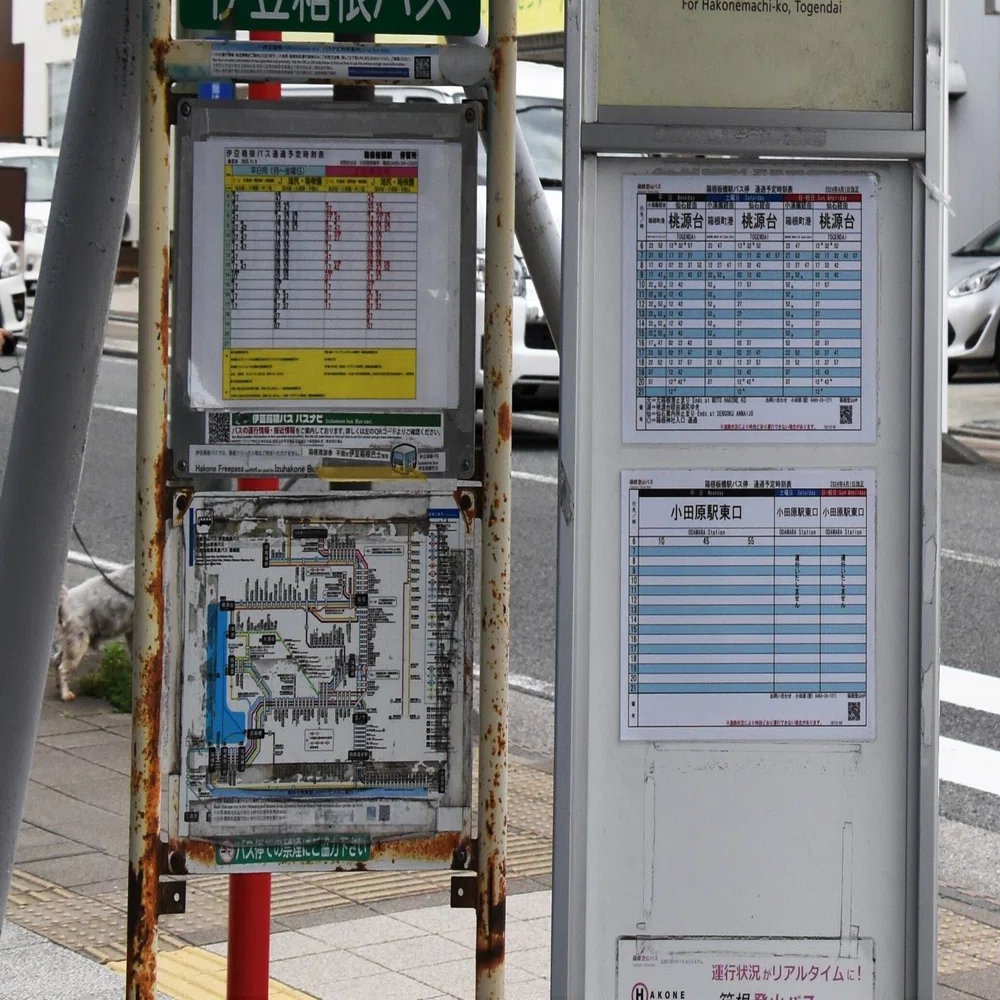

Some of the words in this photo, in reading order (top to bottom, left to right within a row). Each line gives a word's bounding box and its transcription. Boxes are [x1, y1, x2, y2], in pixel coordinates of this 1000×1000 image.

[795, 0, 842, 16] Togendai
[668, 212, 704, 230] 桃源台
[708, 216, 733, 226] 箱根町港
[742, 212, 778, 230] 桃源台
[786, 216, 811, 226] 箱根町港
[819, 212, 855, 230] 桃源台
[218, 465, 244, 473] Freepass
[275, 464, 305, 473] Izuhakone
[671, 504, 742, 520] 小田原駅東口
[777, 507, 818, 517] 小田原駅東口
[823, 507, 864, 517] 小田原駅東口
